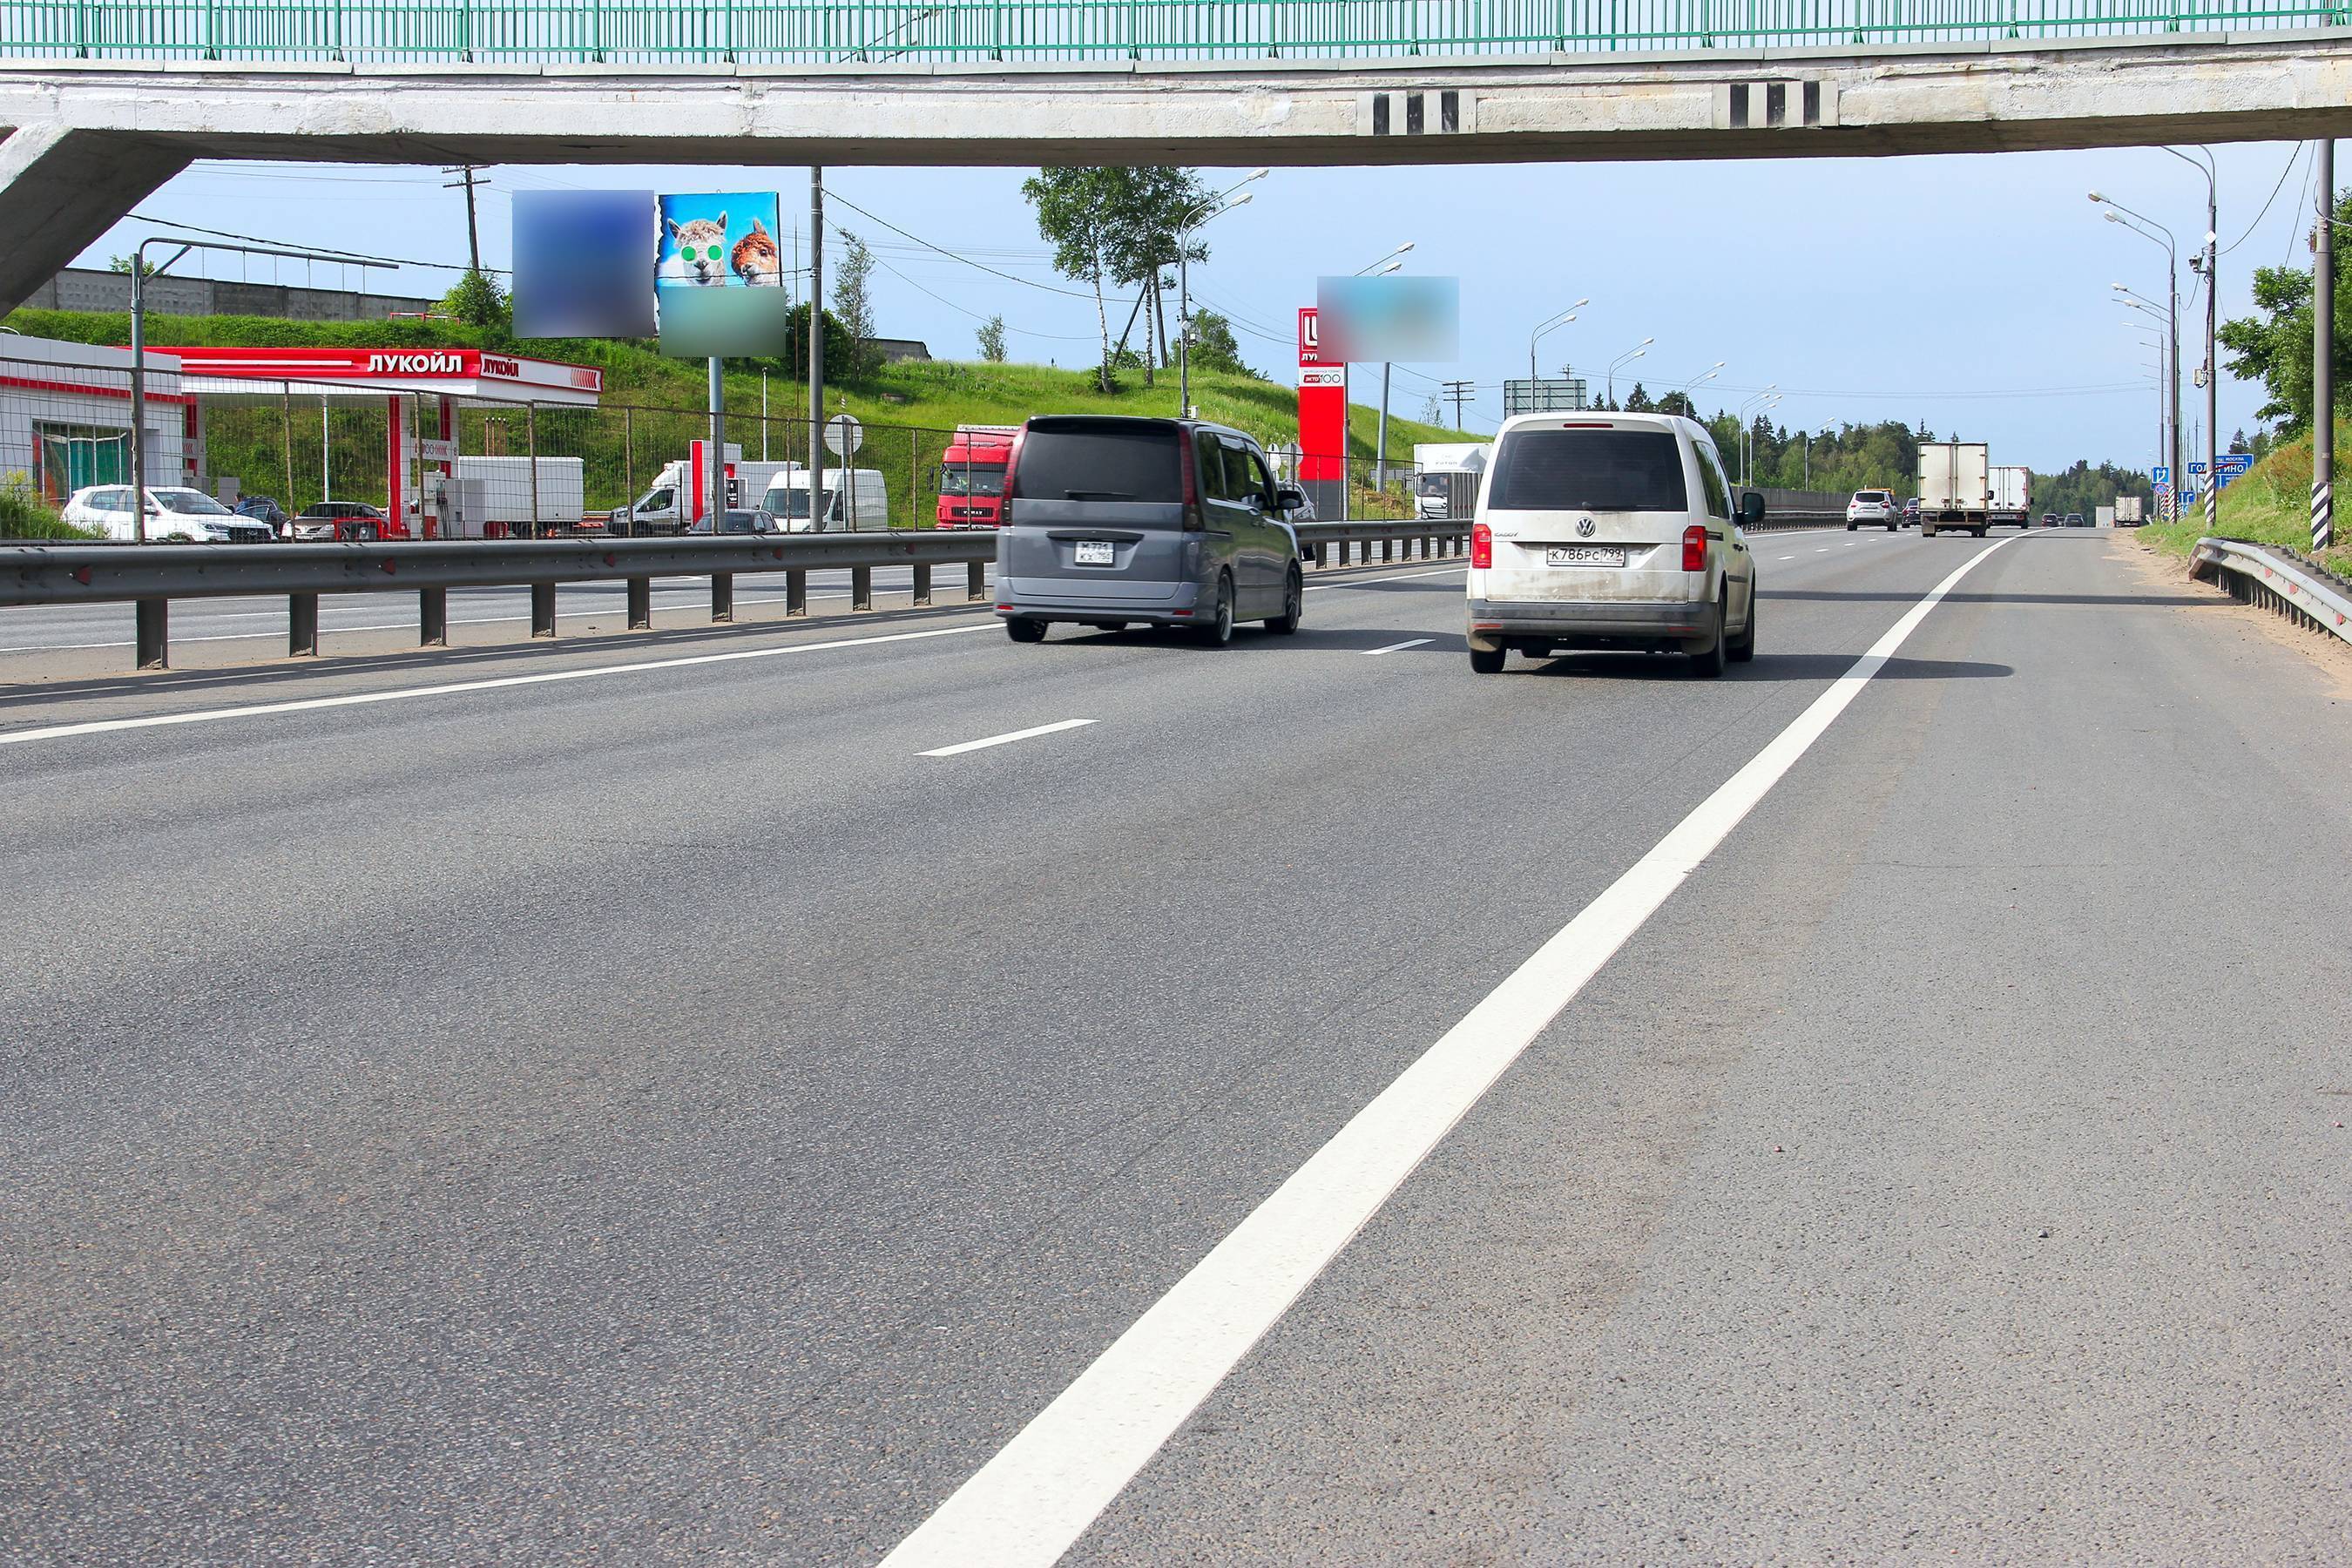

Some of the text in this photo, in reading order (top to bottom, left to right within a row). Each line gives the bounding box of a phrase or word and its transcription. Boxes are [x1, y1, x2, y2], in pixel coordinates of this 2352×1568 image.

[368, 351, 462, 373] ЛУКОЙЛ
[483, 359, 519, 377] ЛУКОЙЛ
[2190, 464, 2244, 473] ГОЛГИНО
